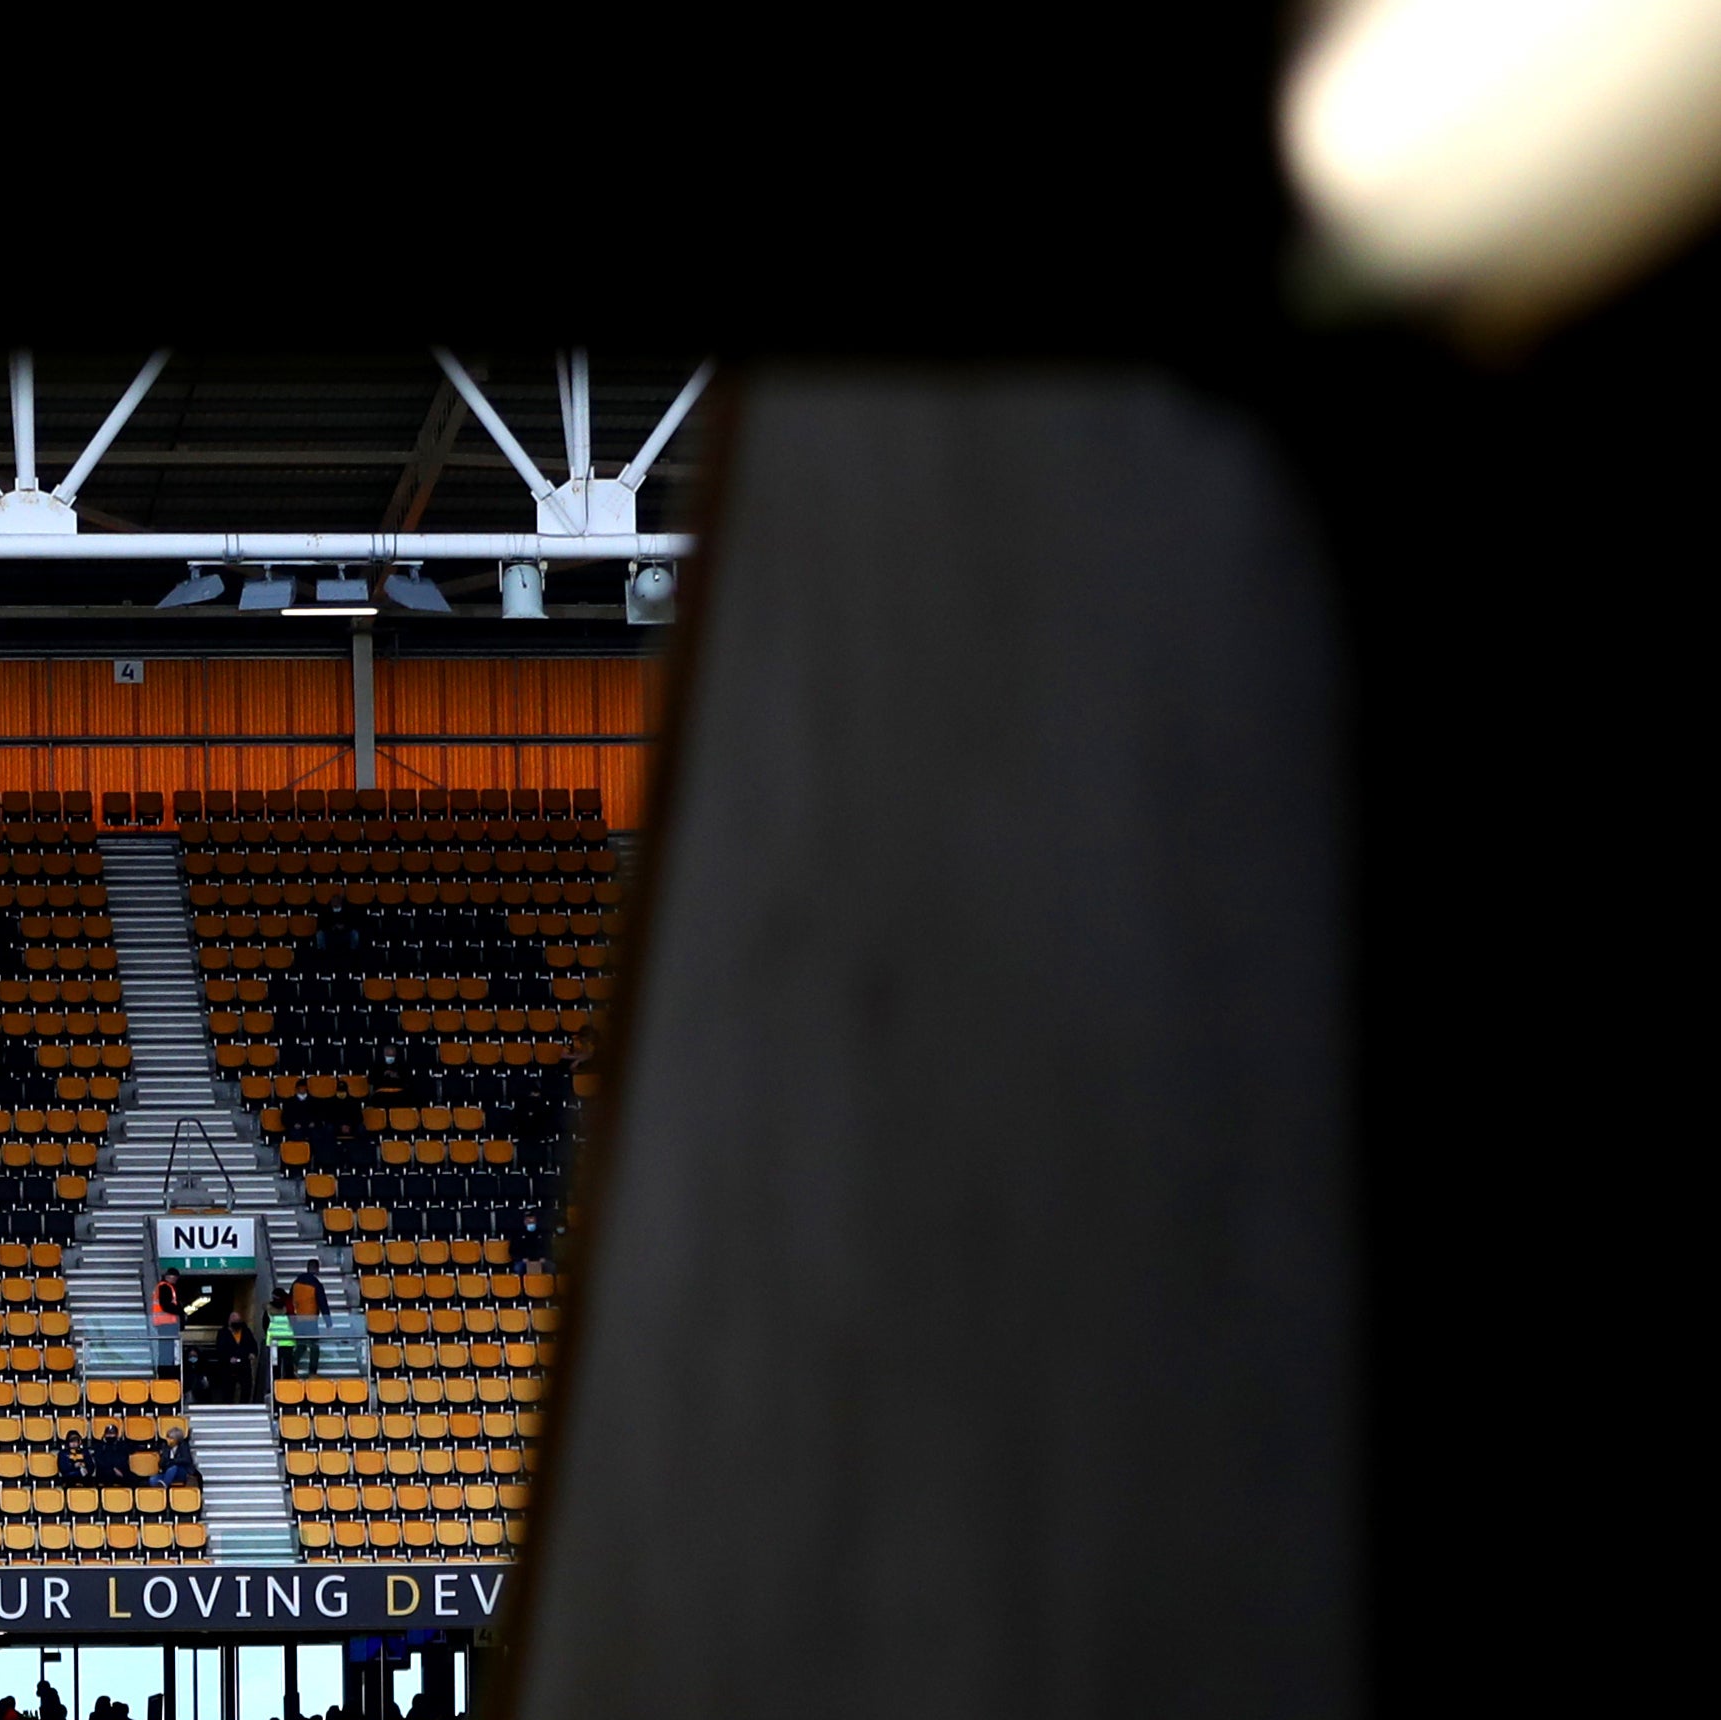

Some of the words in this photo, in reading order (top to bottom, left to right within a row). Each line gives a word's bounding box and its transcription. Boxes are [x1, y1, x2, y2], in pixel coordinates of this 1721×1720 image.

[121, 663, 134, 680] 4
[174, 1225, 238, 1250] NU4
[108, 1574, 349, 1619] LOVING
[386, 1573, 504, 1617] DEV
